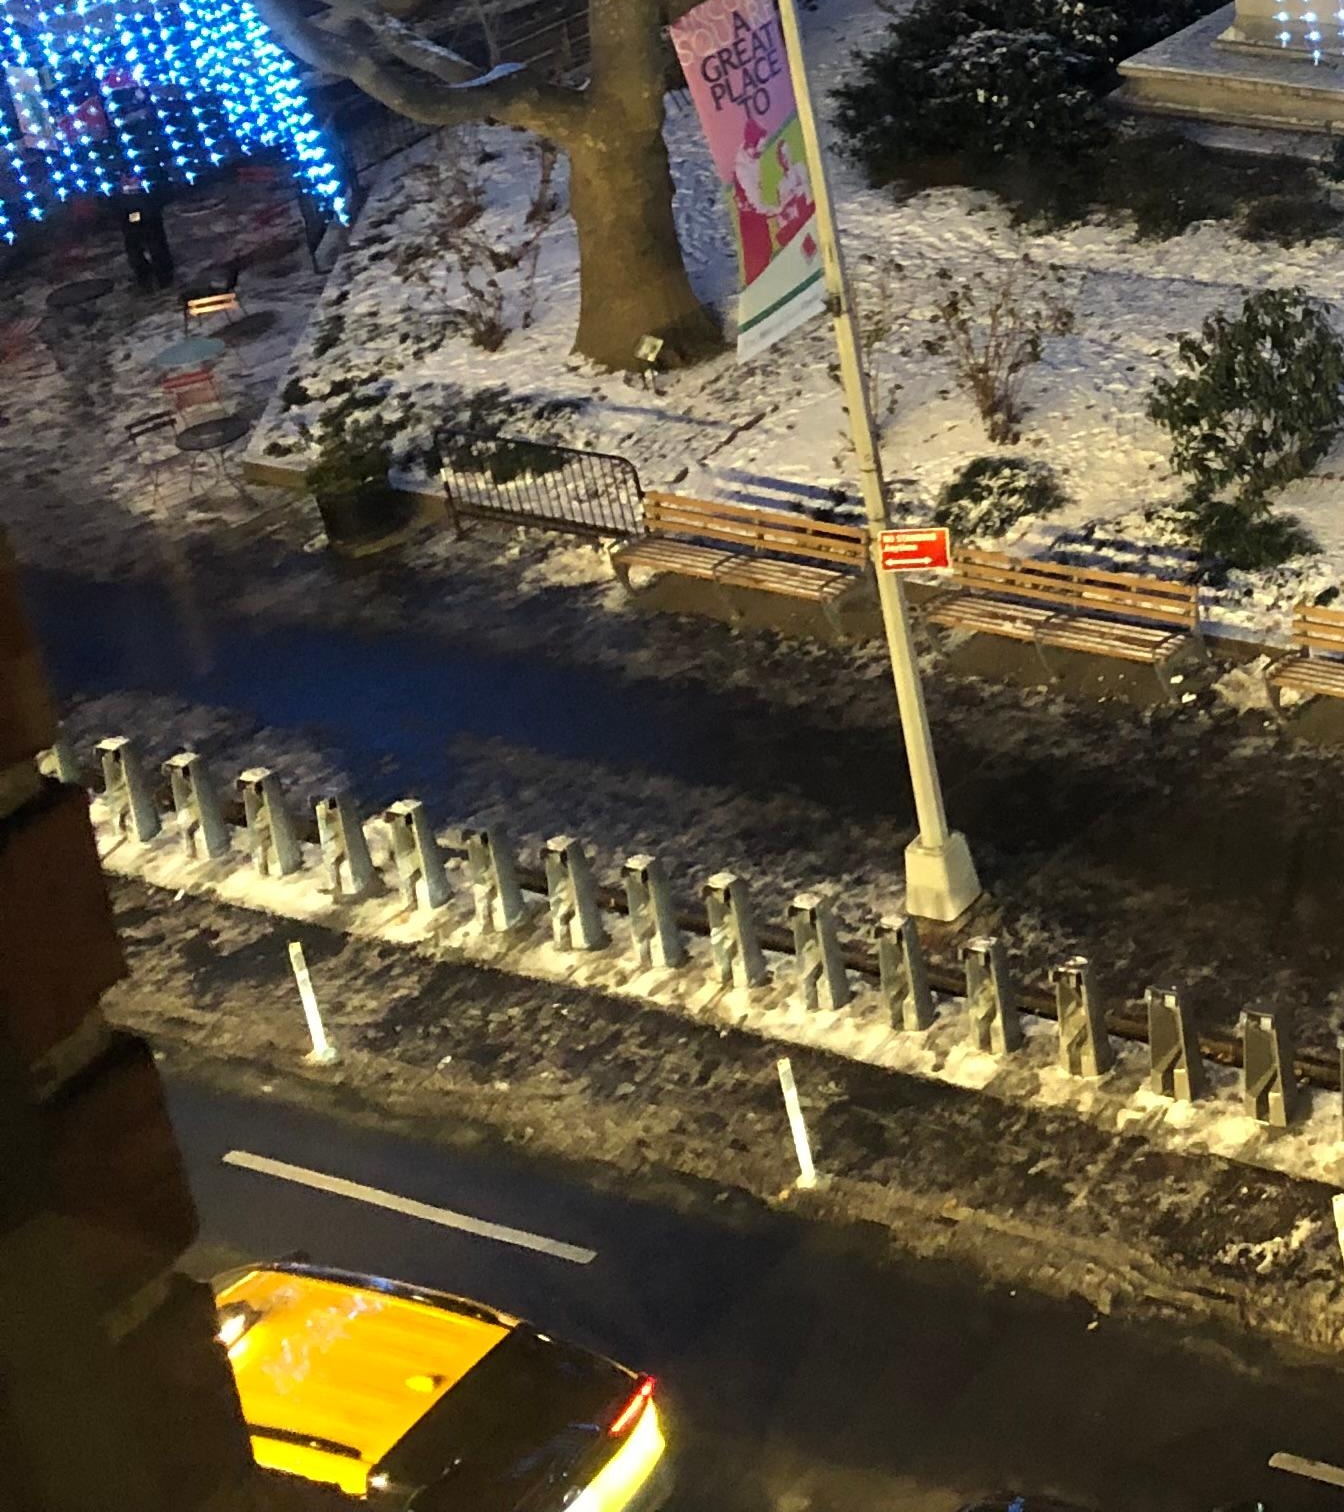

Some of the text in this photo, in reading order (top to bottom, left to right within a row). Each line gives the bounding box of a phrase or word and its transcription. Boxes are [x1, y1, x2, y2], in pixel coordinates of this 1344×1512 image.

[732, 10, 750, 38] A
[701, 21, 776, 83] GREAT
[710, 50, 781, 111] PLACE
[737, 88, 770, 118] TO
